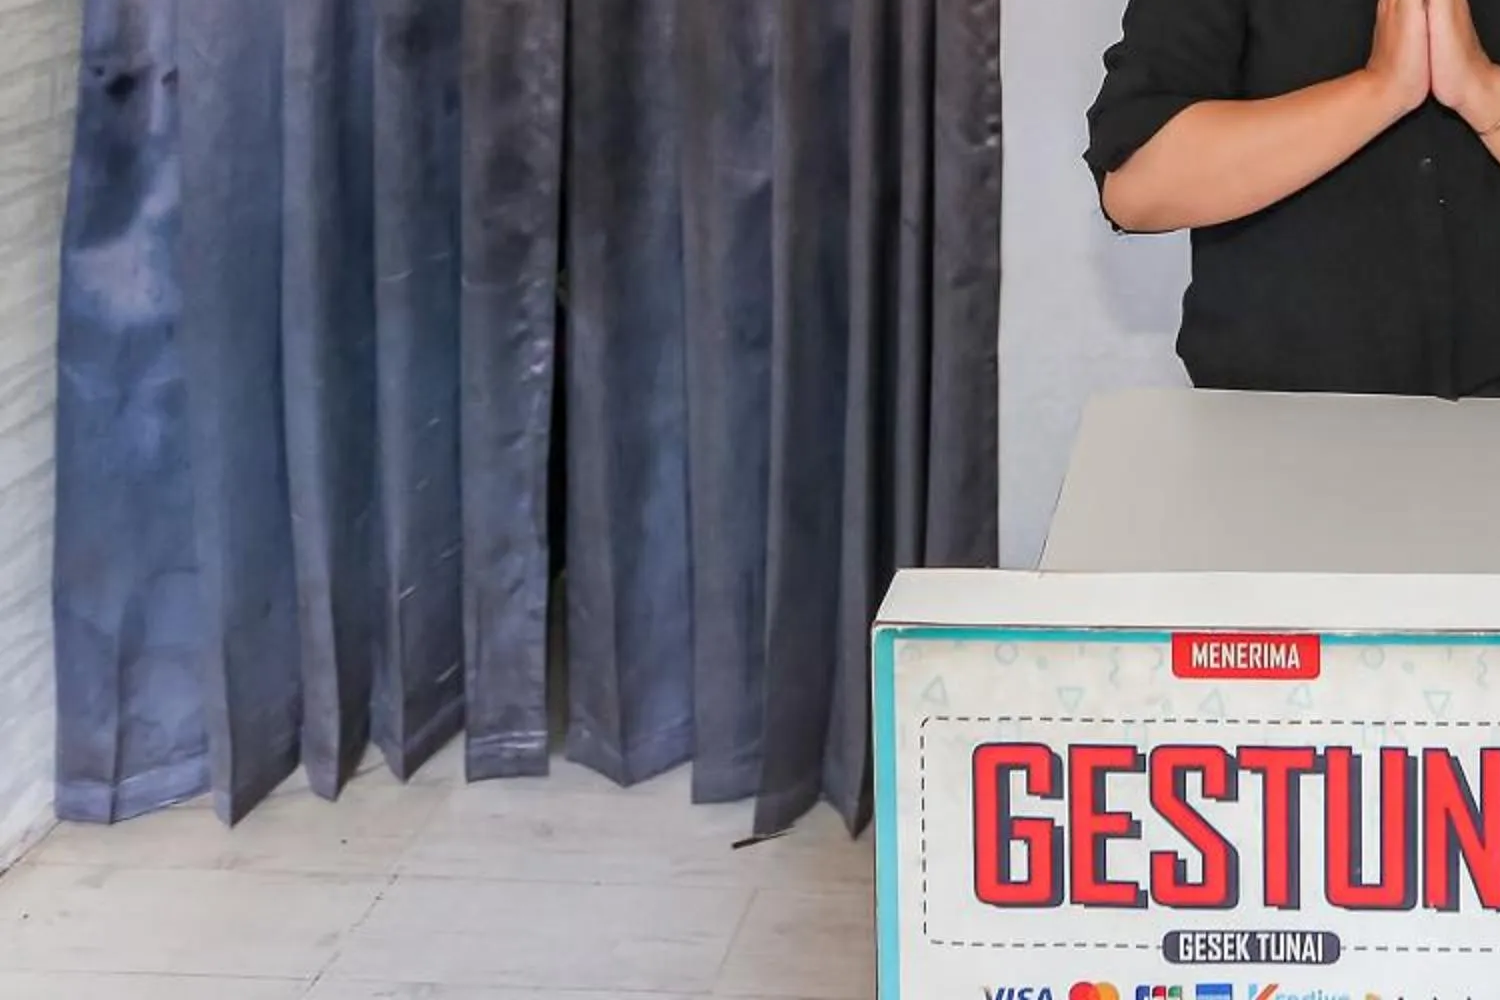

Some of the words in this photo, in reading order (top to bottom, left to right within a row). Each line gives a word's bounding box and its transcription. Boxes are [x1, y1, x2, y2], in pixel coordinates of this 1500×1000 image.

[1191, 642, 1301, 670] MENERIMA
[1178, 933, 1250, 961] GESEK
[1256, 933, 1323, 962] TUNAI
